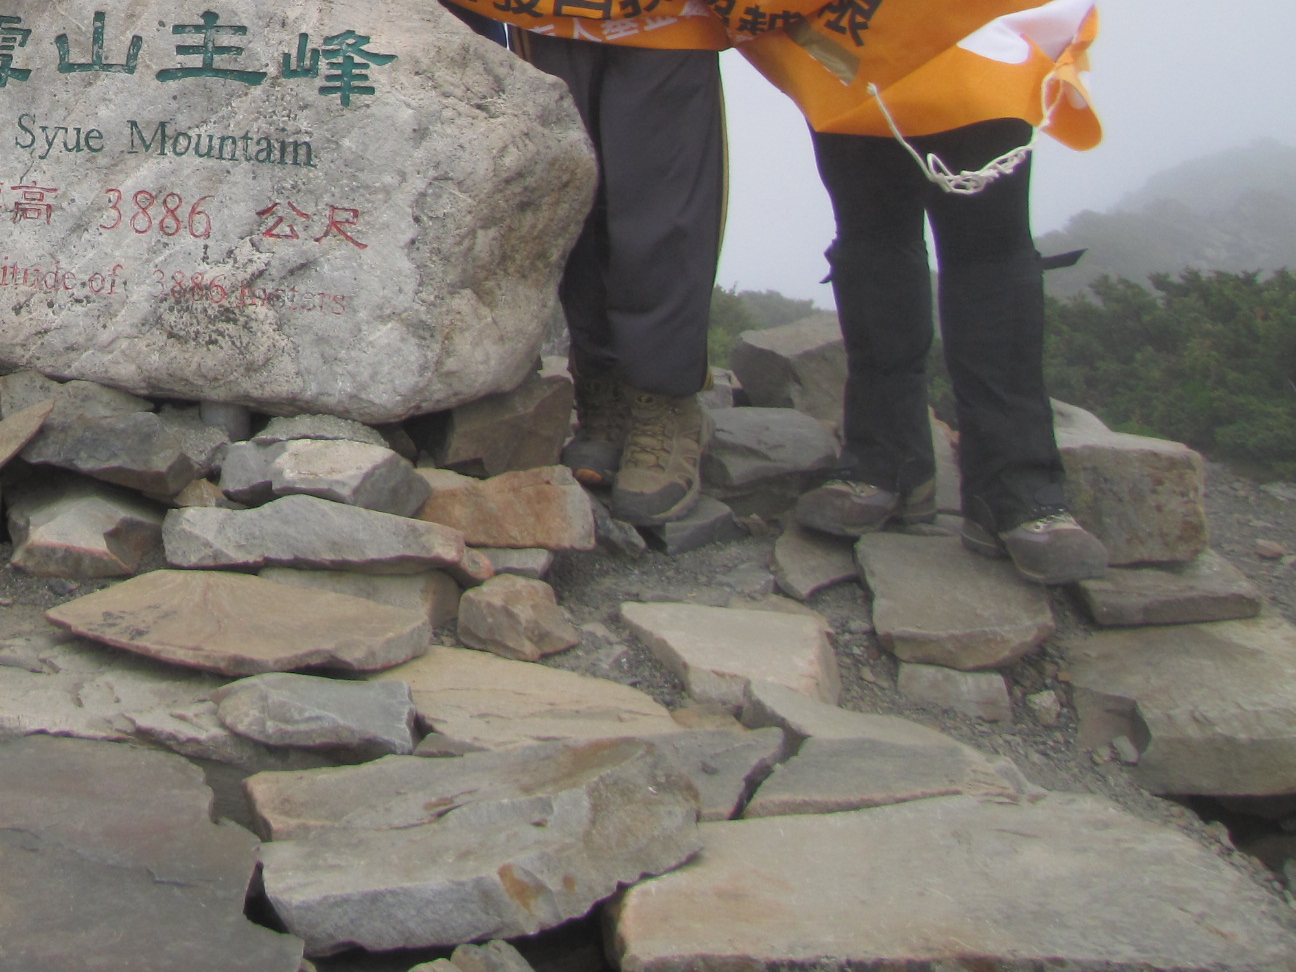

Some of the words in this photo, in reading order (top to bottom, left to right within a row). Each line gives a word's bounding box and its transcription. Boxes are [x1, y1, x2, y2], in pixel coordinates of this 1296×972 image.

[15, 113, 104, 160] Syue
[126, 119, 316, 169] Mountain
[100, 187, 215, 241] 3886
[255, 200, 368, 250] 公尺
[88, 264, 123, 295] of
[151, 268, 228, 306] 3886
